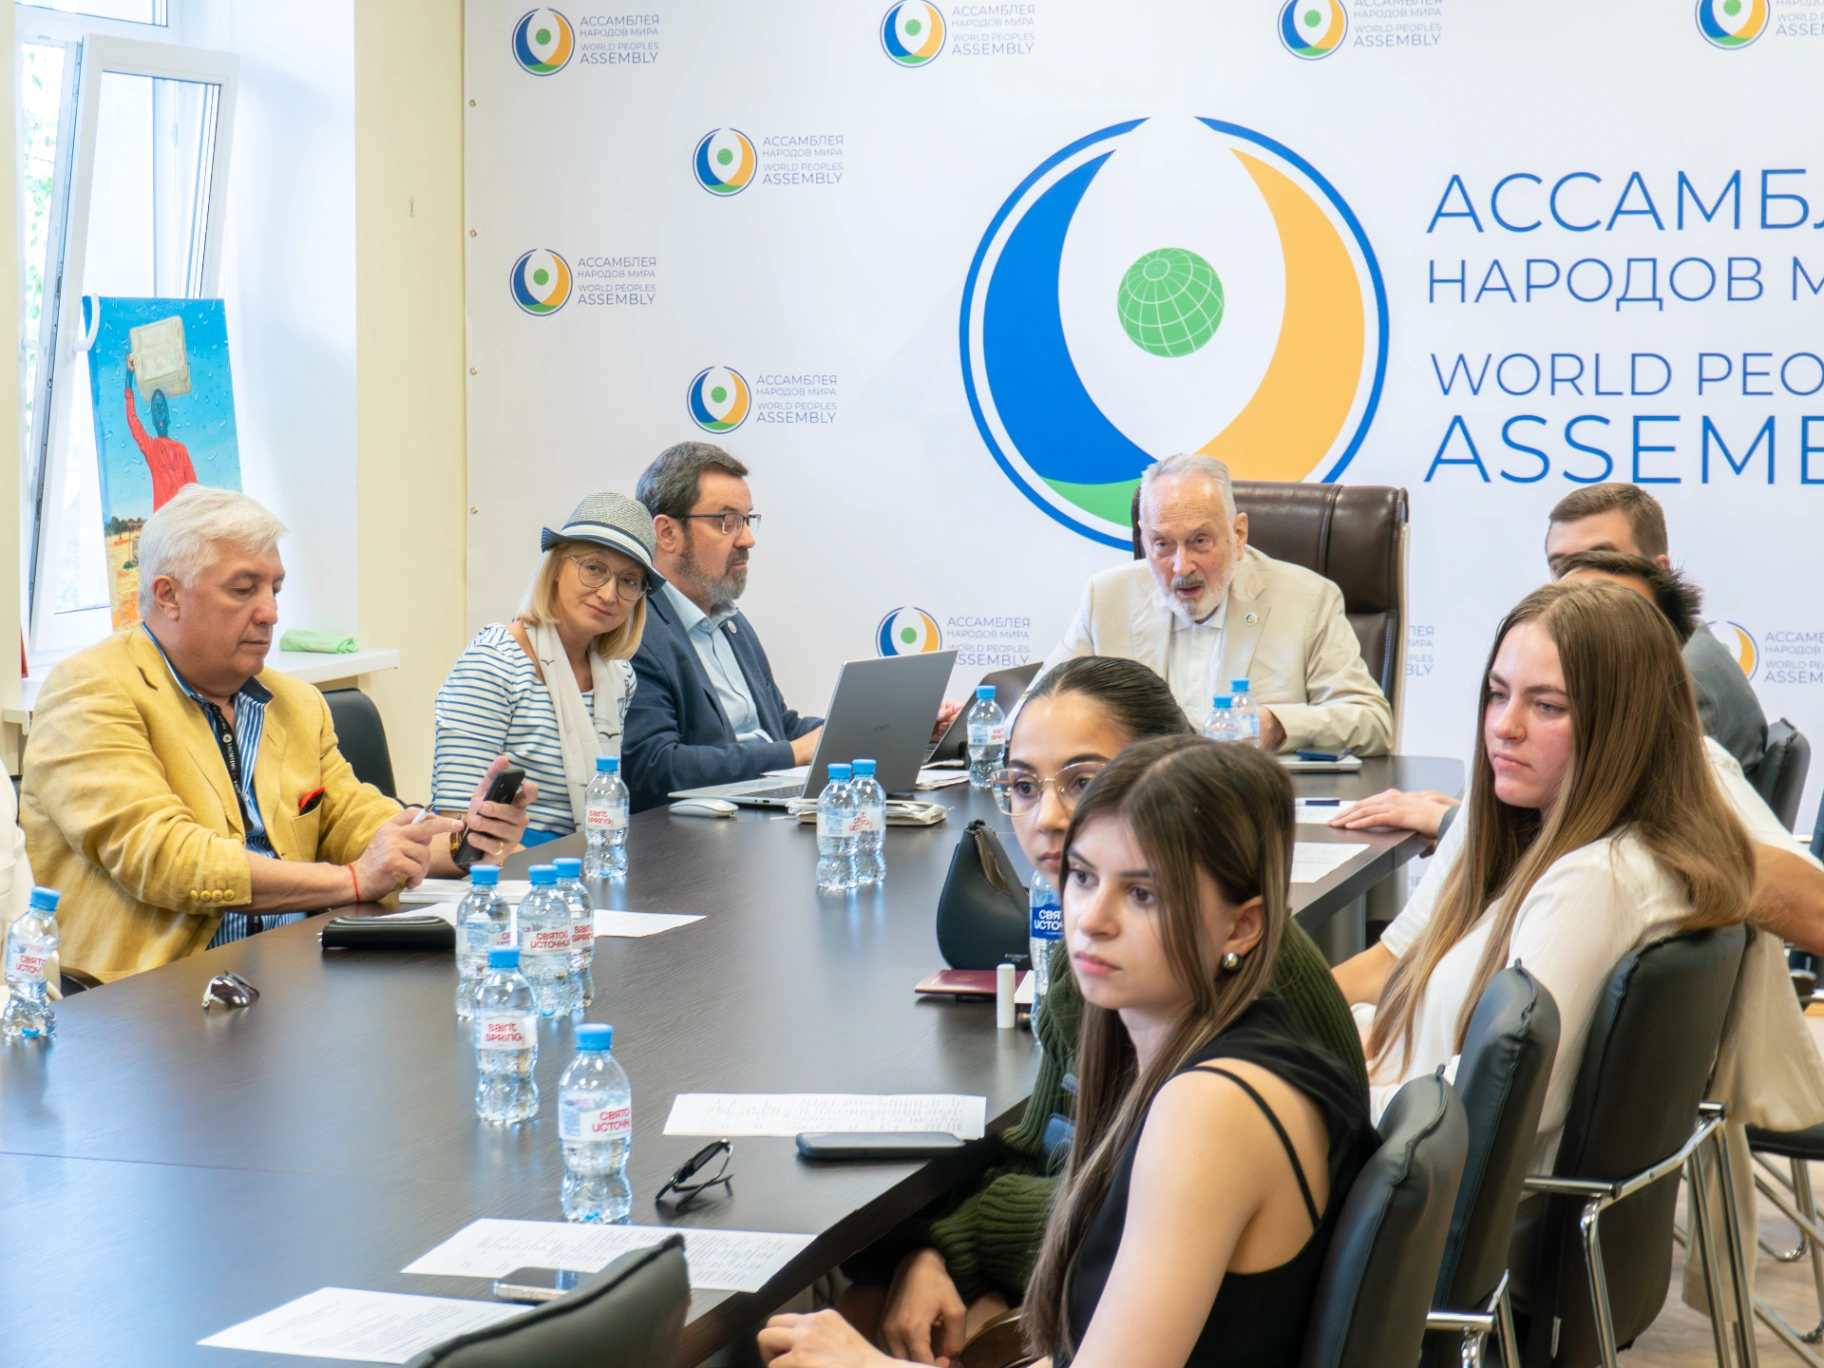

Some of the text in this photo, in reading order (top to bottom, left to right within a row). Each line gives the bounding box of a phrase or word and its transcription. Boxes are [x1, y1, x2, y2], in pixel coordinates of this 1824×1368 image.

[952, 4, 1036, 17] АССАМБЛЕЯ
[1353, 7, 1442, 19] НАРОДОВ МИРА
[580, 14, 660, 27] АССАМБЛЕЯ
[952, 17, 1035, 28] НАРОДОВ МИРА
[1776, 12, 1819, 22] WORLD
[580, 27, 659, 38] НАРОДОВ МИРА
[1354, 23, 1442, 33] WORLD PEOPLES
[1775, 23, 1824, 37] ASSE
[952, 32, 1035, 42] WORLD PEOPLES
[1353, 33, 1442, 48] ASSEMBLY
[580, 42, 659, 51] WORLD PEOPLES
[952, 42, 1035, 56] ASSEMBLY
[580, 51, 659, 65] ASSEMBLY
[762, 135, 844, 147] АССАМБЛЕЯ
[762, 148, 843, 158] НАРОДОВ МИРА
[763, 162, 844, 172] WORLD PEOPLES
[762, 172, 843, 185] ASSEMBLY
[1426, 168, 1824, 234] АССАМБ
[577, 256, 657, 268] АССАМБЛЕЯ
[577, 269, 656, 279] НАРОДОВ МИРА
[578, 283, 657, 293] WORLD PEOPLES
[1429, 256, 1764, 312] НАРОДОВ
[577, 293, 656, 305] ASSEMBLY
[756, 374, 837, 386] АССАМБЛЕЯ
[1430, 353, 1672, 397] WORLD
[756, 387, 837, 397] НАРОДОВ МИРА
[757, 402, 837, 411] WORLD PEOPLES
[756, 411, 837, 424] ASSEMBLY
[947, 616, 1030, 628] АССАМБЛЕЯ
[947, 629, 1029, 639] НАРОДОВ МИРА
[987, 644, 1030, 654] PEOPLES
[954, 653, 1030, 667] SSEMBLY
[1765, 660, 1807, 669] WORLD
[1038, 909, 1062, 920] СВЯ
